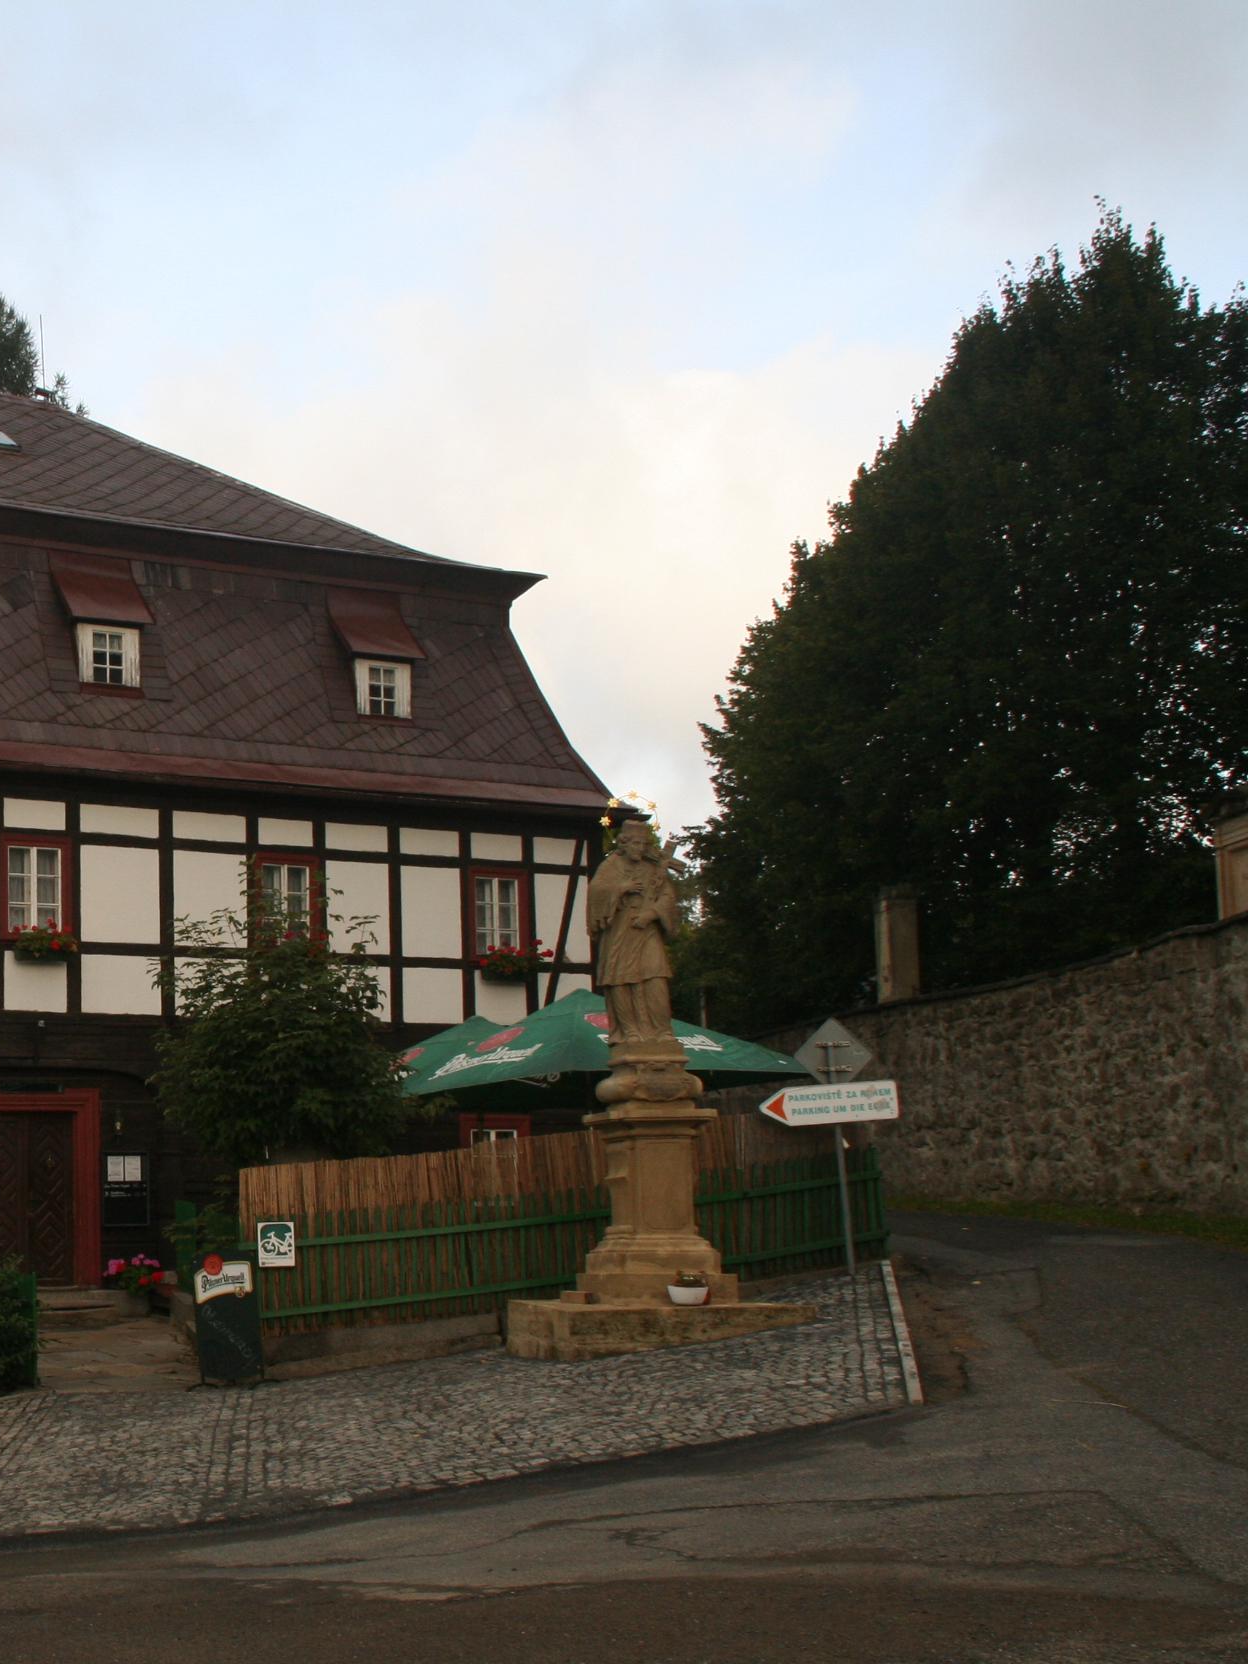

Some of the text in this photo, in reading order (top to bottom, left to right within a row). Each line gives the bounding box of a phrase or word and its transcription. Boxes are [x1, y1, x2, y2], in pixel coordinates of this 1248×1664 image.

[787, 1089, 843, 1102] PARKOVIŠTĚ
[846, 1090, 857, 1098] ZA
[791, 1104, 831, 1116] PARKING
[833, 1104, 847, 1113] UM
[851, 1103, 865, 1112] DIE
